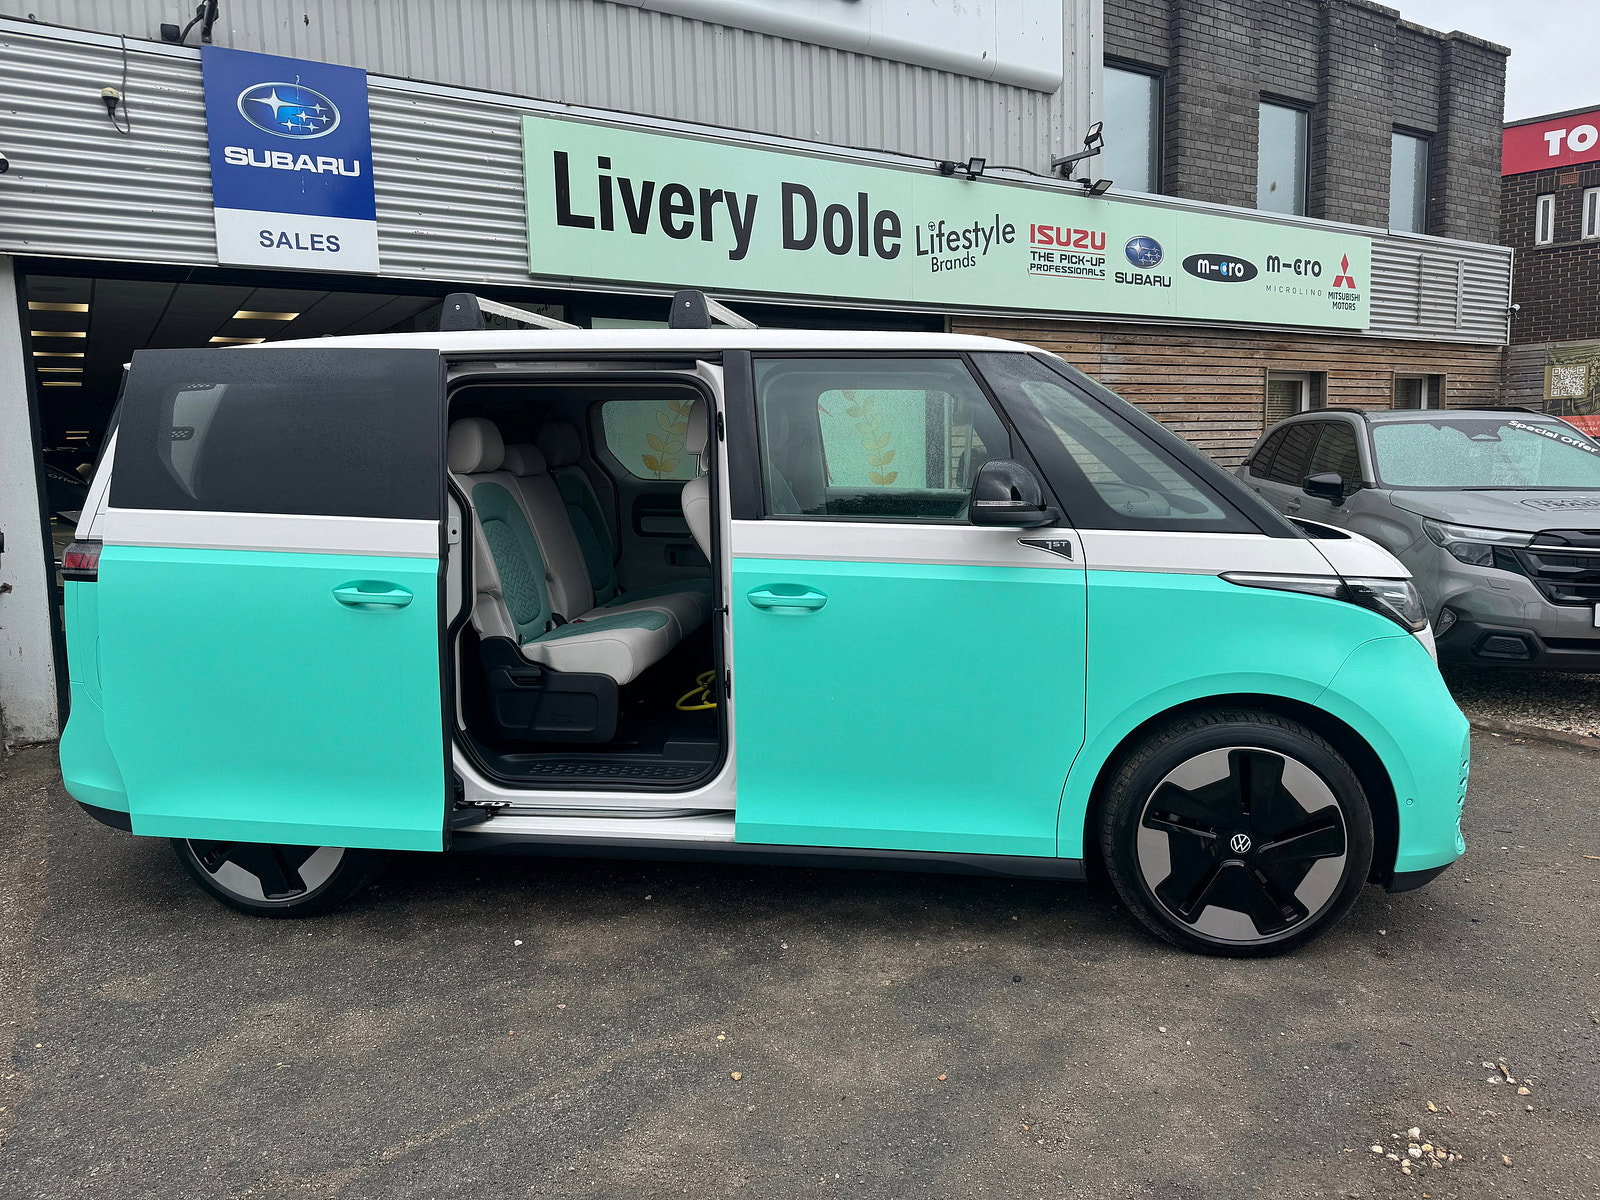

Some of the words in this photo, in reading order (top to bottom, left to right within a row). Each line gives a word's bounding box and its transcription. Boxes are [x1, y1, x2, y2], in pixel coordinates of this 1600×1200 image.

[224, 145, 361, 178] SUBARU
[553, 151, 758, 261] Livery
[781, 182, 902, 260] Dole
[259, 229, 341, 253] SALES
[915, 213, 1016, 256] Lifestyle
[1029, 223, 1106, 250] ISUZU
[931, 252, 977, 273] Brands
[1030, 250, 1055, 264] THE
[1059, 253, 1106, 267] PICK-UP
[1029, 263, 1106, 277] PROFESSIONALS
[1114, 272, 1172, 288] SUBARU
[1265, 284, 1323, 297] MICROLINO
[1328, 291, 1361, 302] MITSUBISHI
[1332, 301, 1356, 311] MOTORS
[1508, 419, 1559, 439] Special
[1560, 435, 1599, 453] Offer
